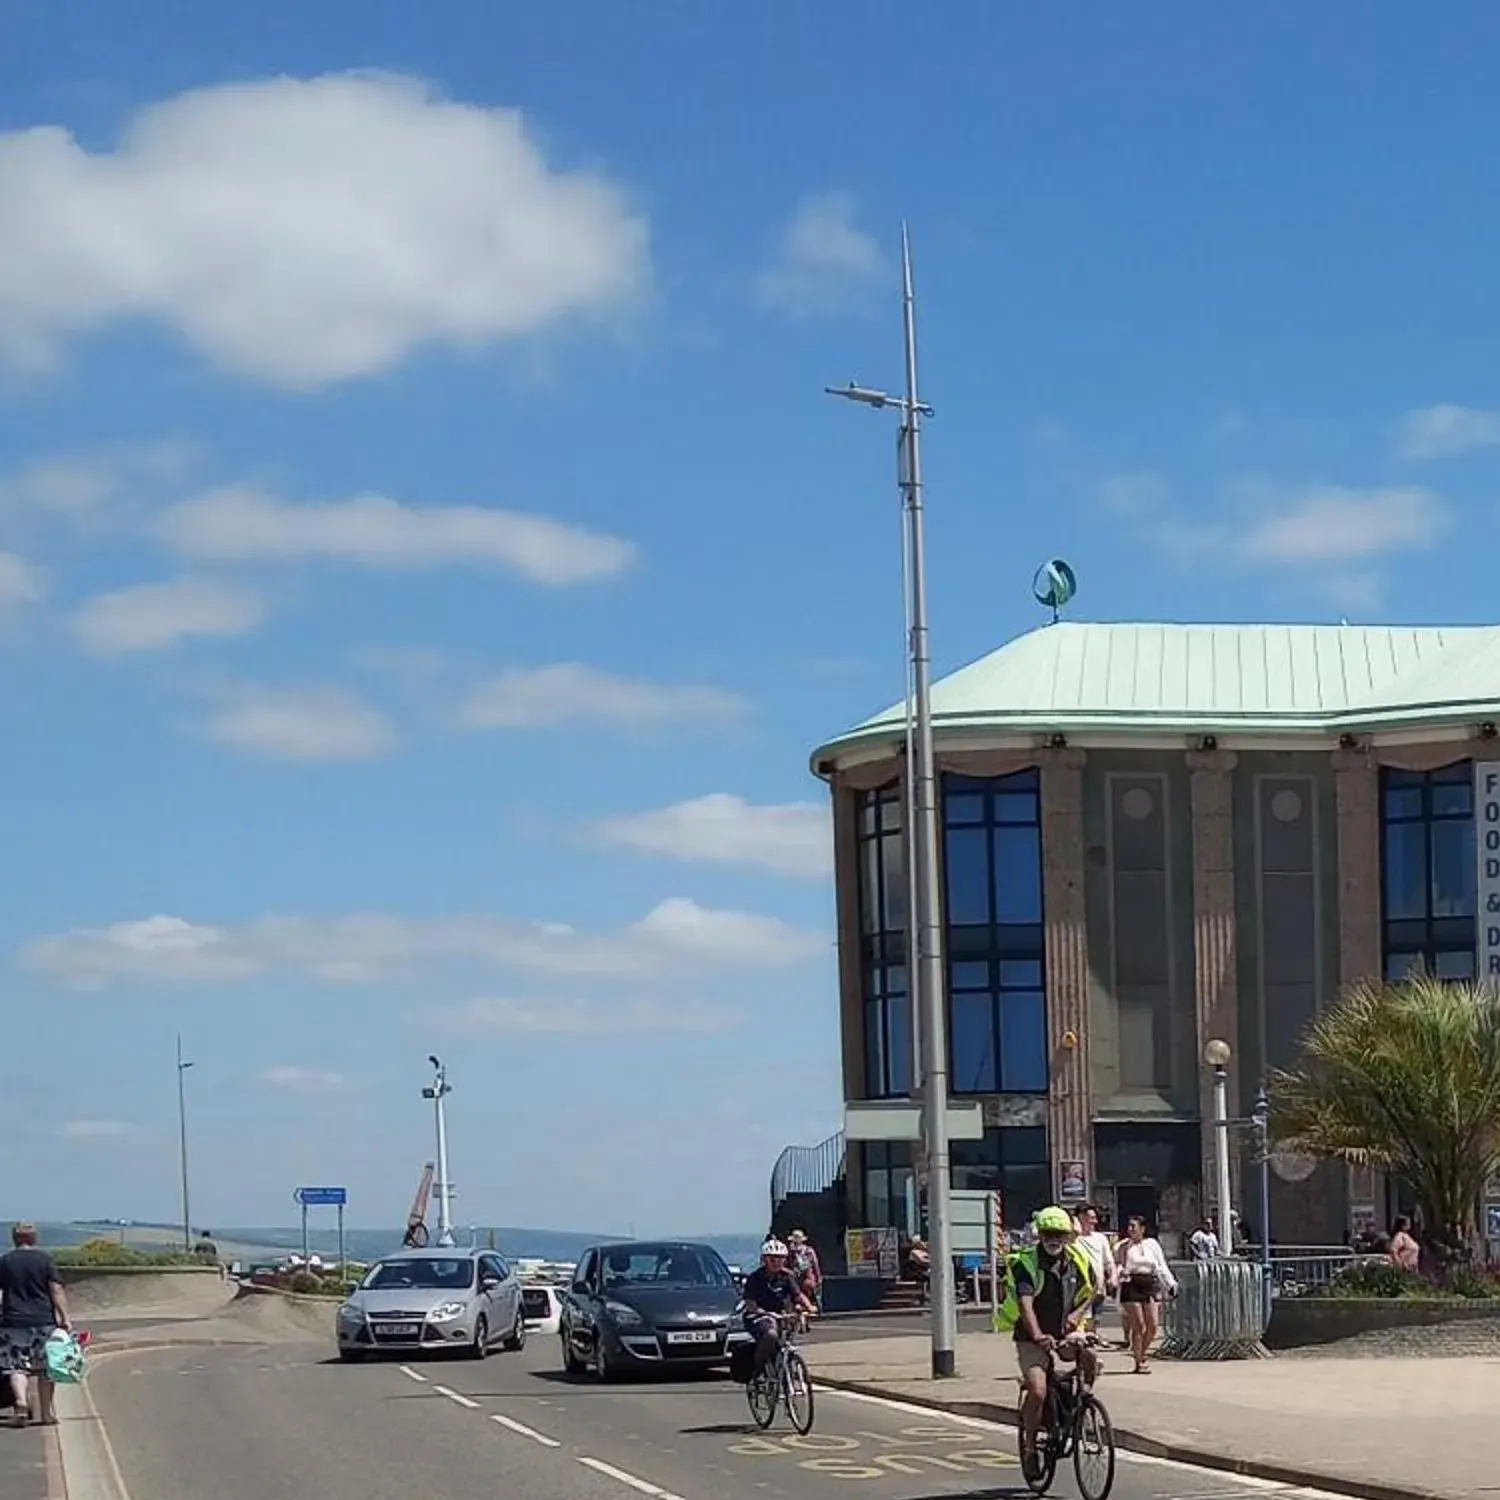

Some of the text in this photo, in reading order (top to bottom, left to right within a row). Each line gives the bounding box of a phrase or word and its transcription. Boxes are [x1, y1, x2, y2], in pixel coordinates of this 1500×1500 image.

[1485, 773, 1500, 880] FOOD
[1486, 892, 1500, 914] &
[726, 1426, 983, 1456] STOP
[797, 1448, 1023, 1480] BUS
